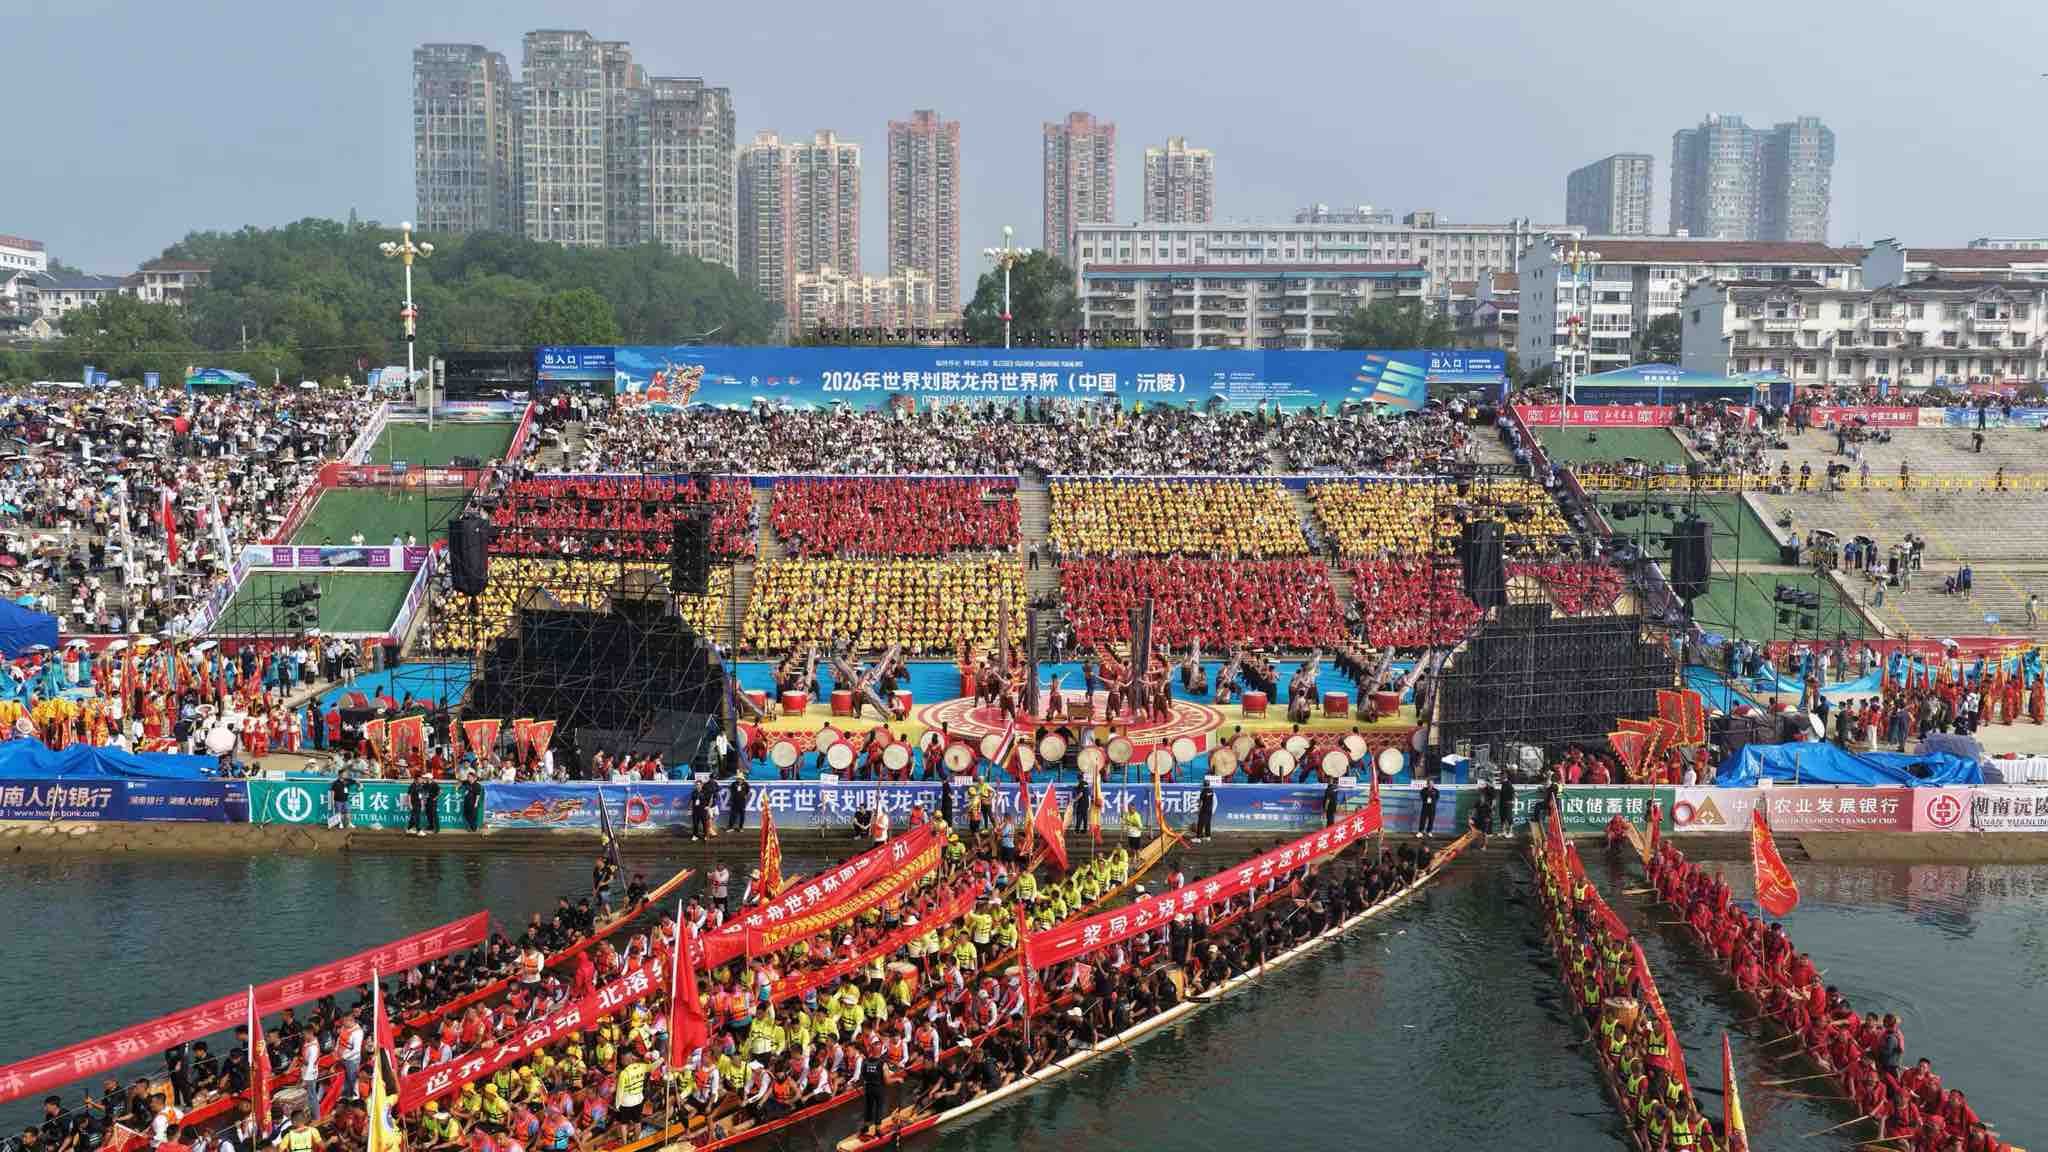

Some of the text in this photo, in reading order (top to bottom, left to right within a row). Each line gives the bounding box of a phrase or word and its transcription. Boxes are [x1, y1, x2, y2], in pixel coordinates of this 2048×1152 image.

[544, 353, 576, 365] 出入口
[1431, 358, 1462, 369] 出入口
[0, 785, 113, 808] 南人的银行
